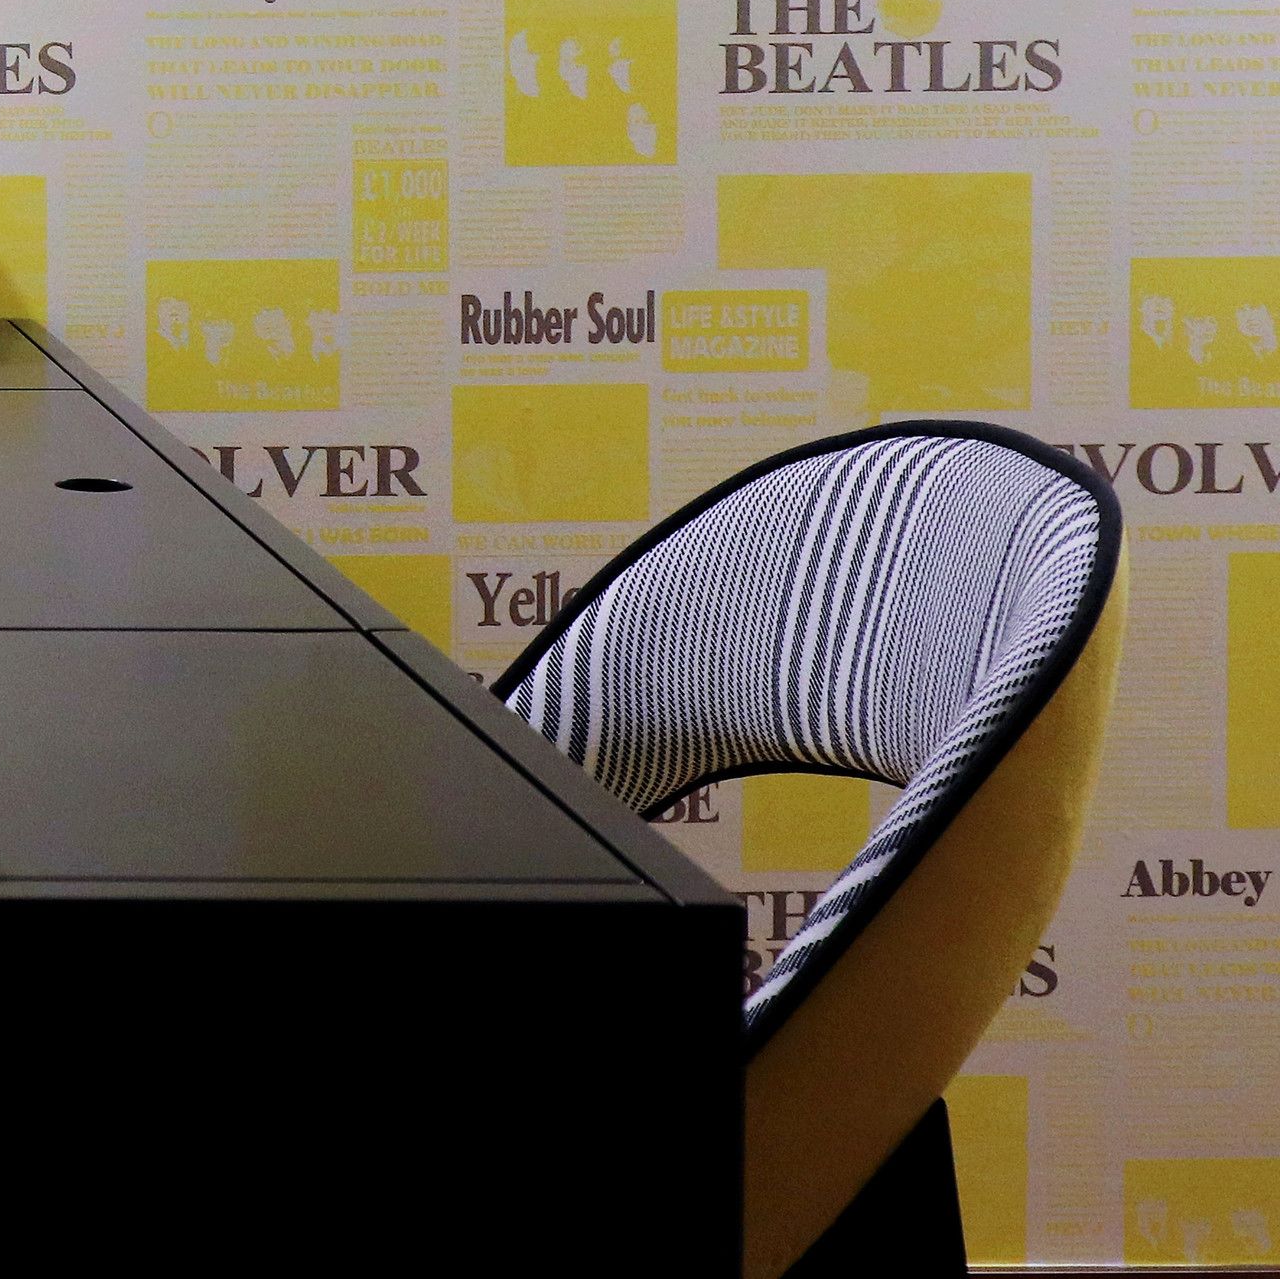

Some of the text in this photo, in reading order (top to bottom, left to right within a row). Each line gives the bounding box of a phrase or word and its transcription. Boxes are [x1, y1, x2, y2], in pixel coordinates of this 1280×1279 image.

[719, 40, 1062, 94] BEATLES
[461, 290, 655, 345] Rubber Soul
[466, 570, 581, 627] Yell
[1121, 859, 1272, 907] Abbey
